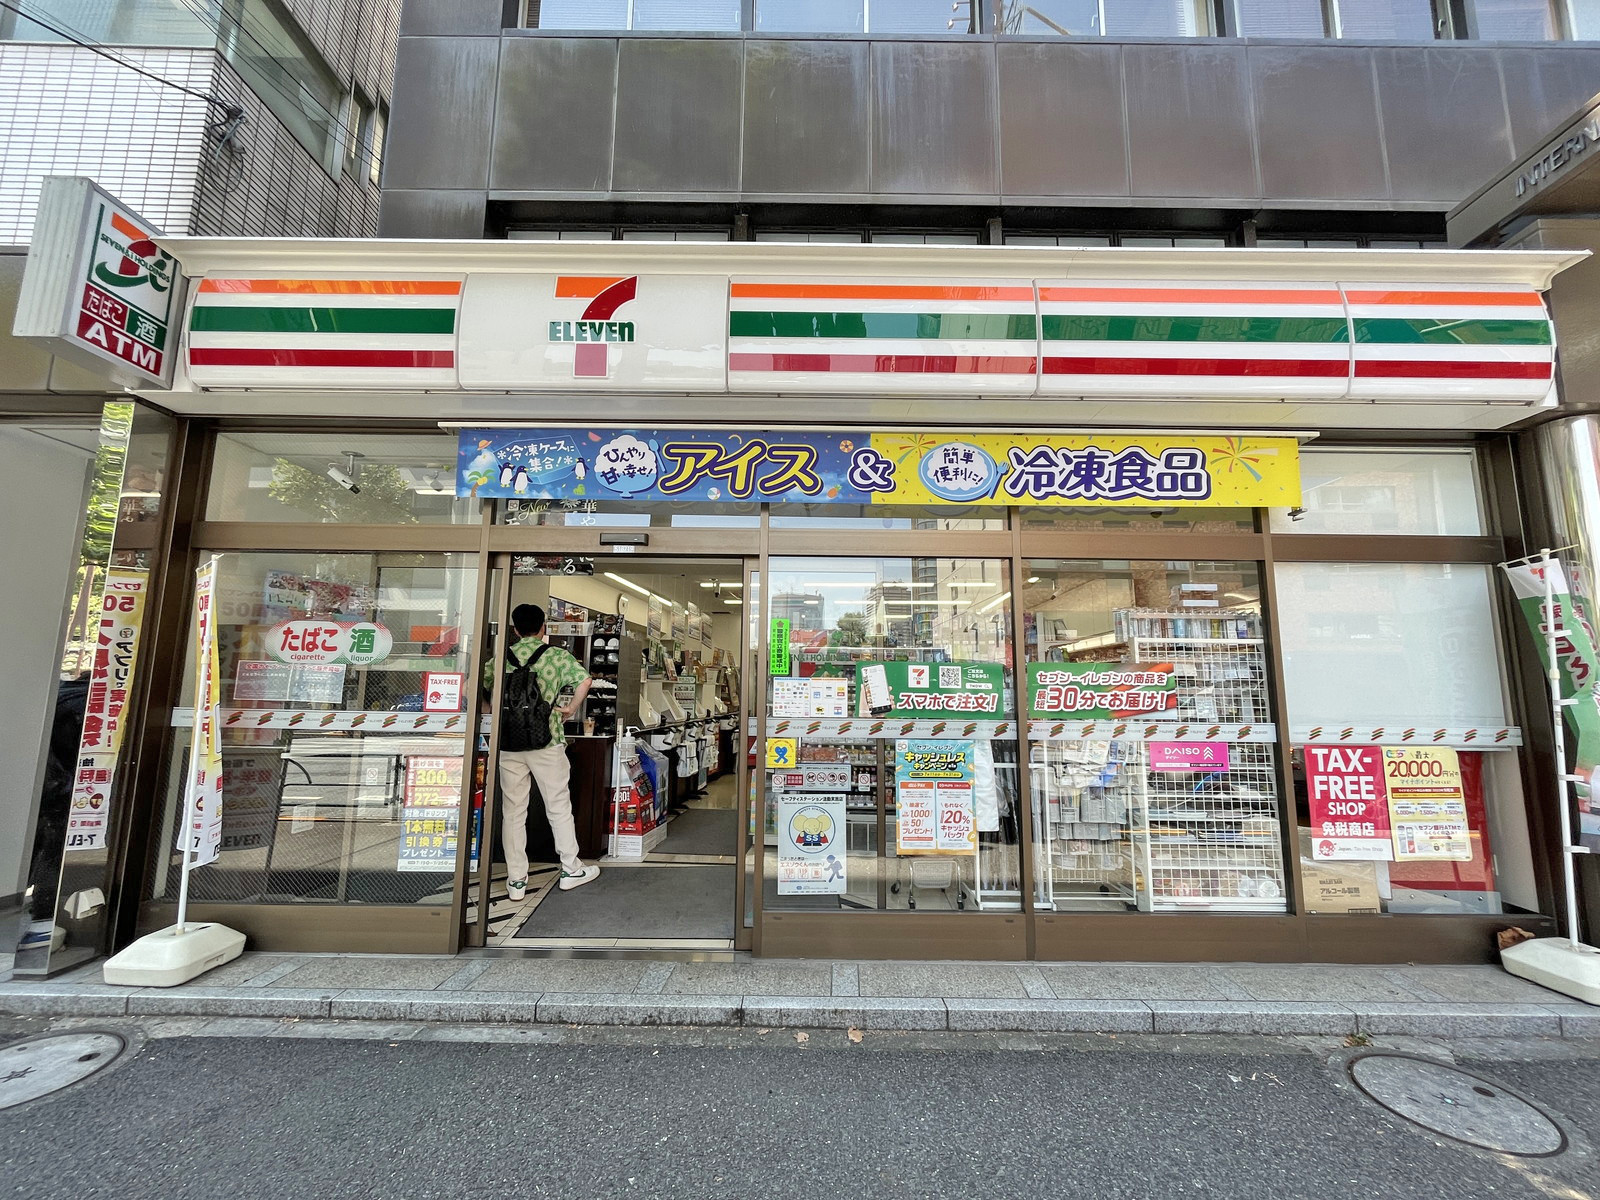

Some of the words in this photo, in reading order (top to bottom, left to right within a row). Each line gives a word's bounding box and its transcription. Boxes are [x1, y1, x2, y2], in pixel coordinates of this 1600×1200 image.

[1515, 118, 1600, 197] INTERN
[134, 256, 170, 283] HOLDINGS
[86, 290, 123, 325] たばこ
[135, 315, 157, 344] 酒
[85, 322, 156, 371] ATM
[507, 440, 575, 461] 冷凍ケースに
[603, 447, 646, 463] ひんやり
[942, 447, 974, 465] 簡単
[600, 464, 653, 485] 甘い幸せ!
[660, 441, 823, 496] アイス
[848, 448, 895, 491] &
[1006, 447, 1208, 496] 冷凍食品
[281, 626, 339, 653] たばこ
[349, 628, 375, 654] 酒
[290, 653, 326, 661] cigarette
[350, 653, 374, 662] liquor
[898, 693, 998, 712] スマホで注文!
[904, 752, 965, 763] キャッシュレス
[1164, 747, 1200, 755] DAISO
[1311, 748, 1373, 772] TAX-
[1314, 775, 1376, 800] FREE
[1328, 802, 1367, 816] SHOP
[1321, 822, 1375, 837] 免税商店
